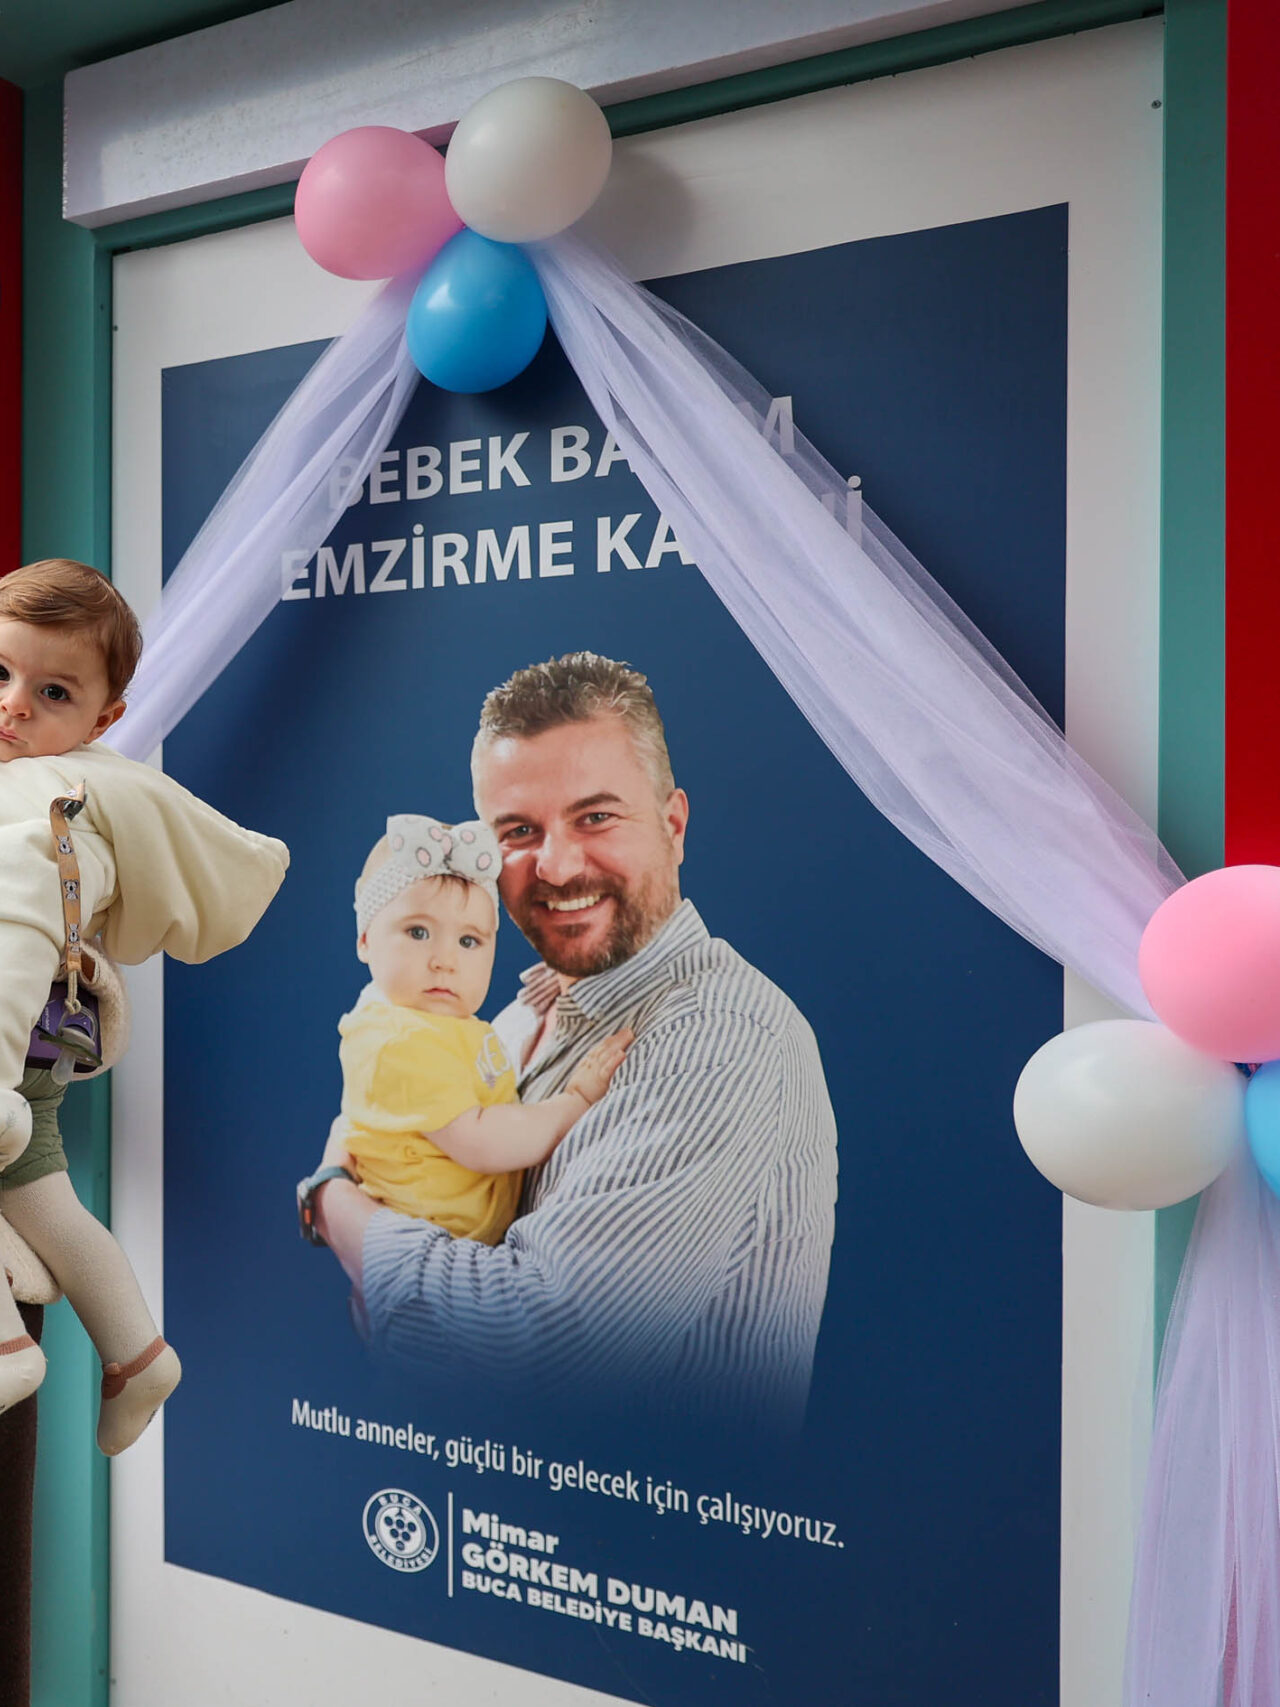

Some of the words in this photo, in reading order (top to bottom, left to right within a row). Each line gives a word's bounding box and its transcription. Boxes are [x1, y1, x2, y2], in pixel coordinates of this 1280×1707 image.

[330, 431, 532, 511] BEBEK
[281, 520, 575, 602] EMZİRME
[291, 1398, 351, 1437] Mutlu
[355, 1419, 440, 1461] anneler,
[445, 1437, 505, 1474] güçlü
[512, 1446, 543, 1479] bir
[548, 1460, 640, 1502] gelecek
[646, 1476, 689, 1515] için
[696, 1492, 845, 1548] çalışıyoruz.
[462, 1508, 559, 1555] Mimar
[461, 1541, 598, 1598] GÖRKEM
[607, 1577, 738, 1635] DUMAN
[461, 1570, 522, 1602] BUCA
[526, 1587, 633, 1632] BELEDİYE
[637, 1616, 747, 1664] BAŞKANI
